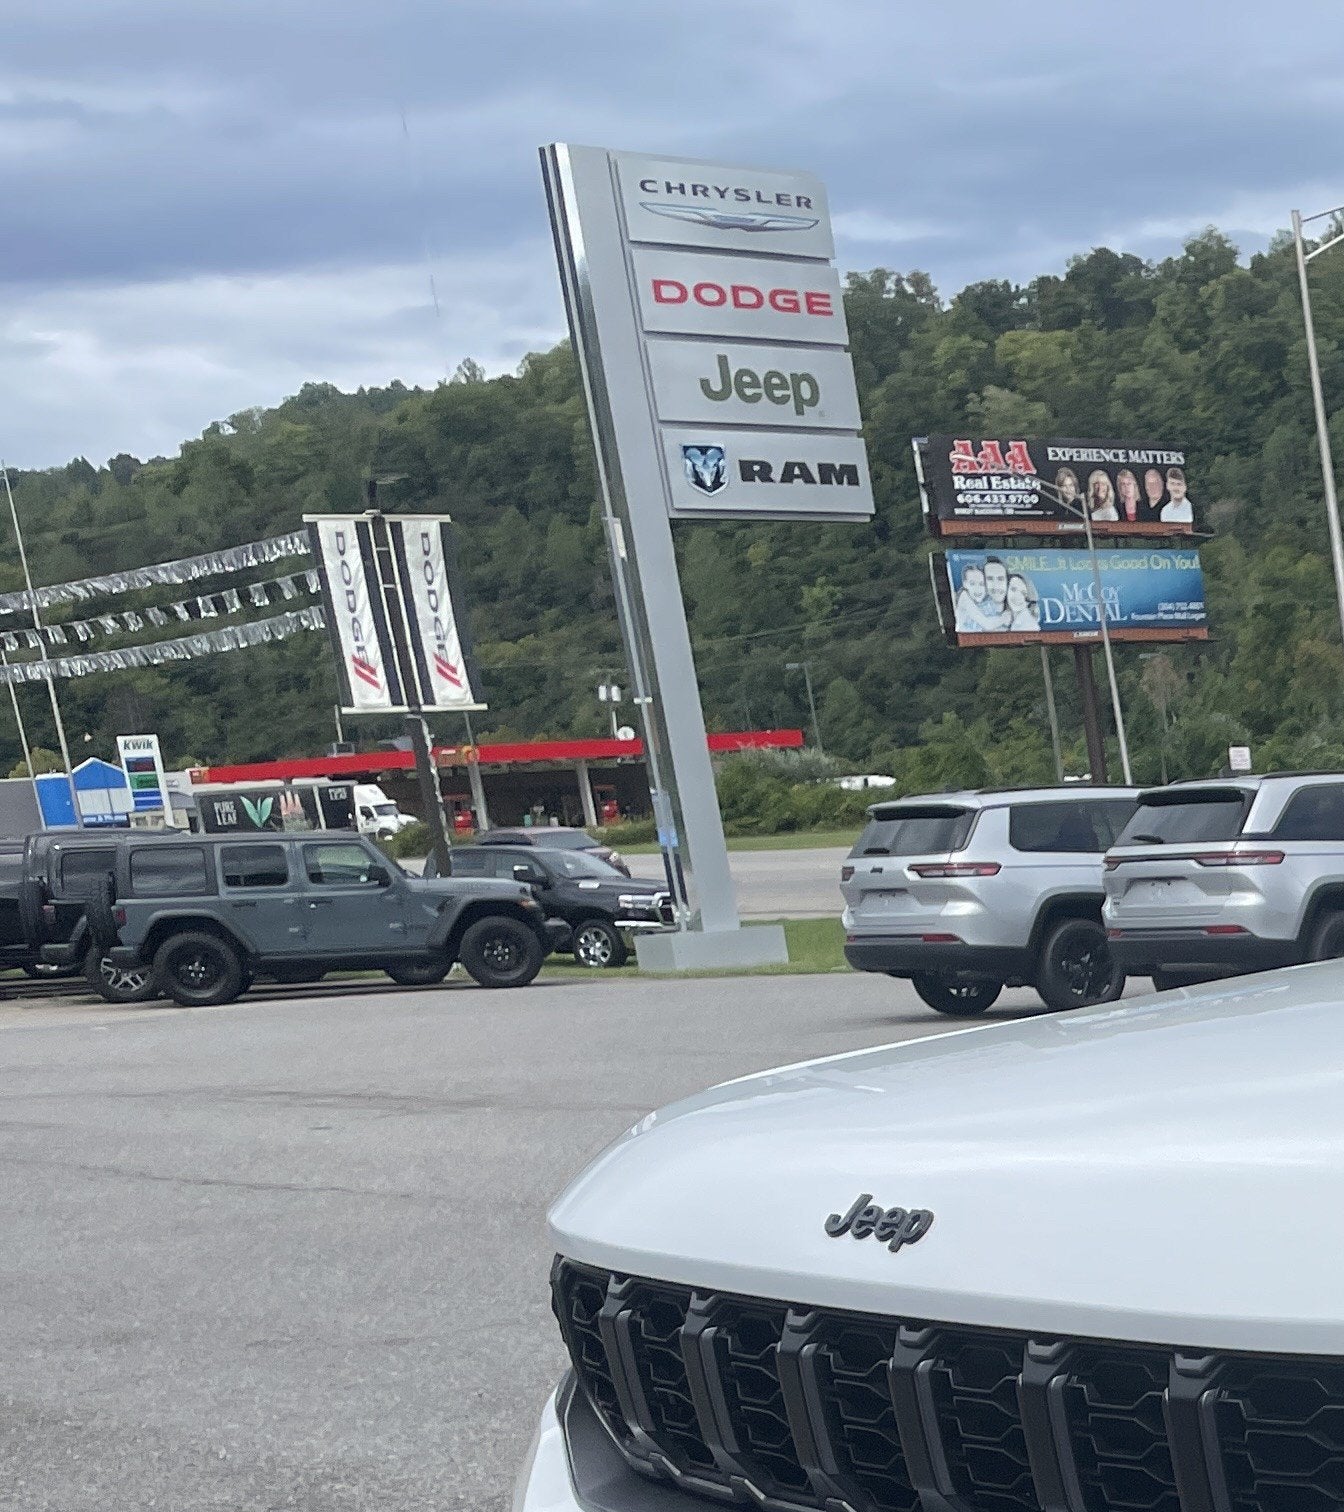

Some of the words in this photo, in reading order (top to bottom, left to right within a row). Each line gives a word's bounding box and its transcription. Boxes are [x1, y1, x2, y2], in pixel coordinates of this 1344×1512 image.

[640, 179, 812, 210] CHRYSLER
[652, 279, 834, 317] DODGE
[701, 354, 820, 416] Jeep
[949, 440, 1037, 475] AAA
[1047, 447, 1127, 463] EXPERIENCE
[1128, 449, 1186, 465] MATTERS
[738, 459, 860, 487] RAM
[952, 475, 988, 490] Real
[823, 1193, 935, 1253] Jeep
